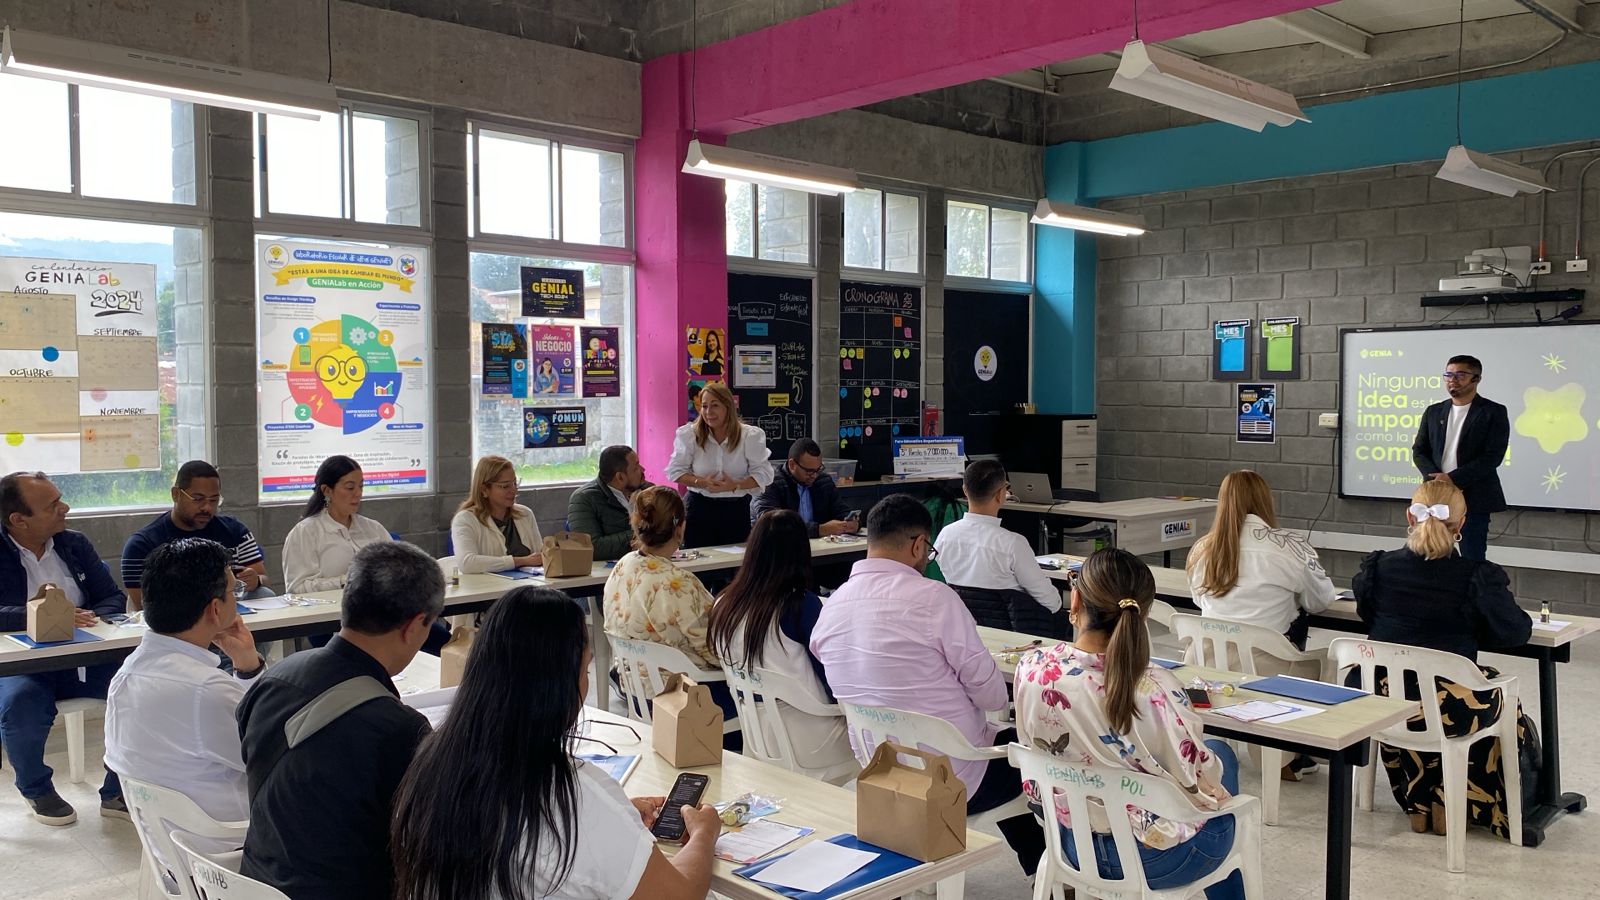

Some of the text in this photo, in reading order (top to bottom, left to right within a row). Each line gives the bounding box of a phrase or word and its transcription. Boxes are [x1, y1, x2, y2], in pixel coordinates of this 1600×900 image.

[312, 279, 346, 287] GENIALab
[532, 282, 574, 294] GENIAL
[14, 285, 49, 295] AGOSTO
[90, 288, 142, 310] 2024
[844, 288, 900, 308] CRONOGRAMA
[94, 328, 142, 336] SEPTIEMBRE
[536, 341, 572, 352] NEGOCIO
[10, 368, 53, 378] OCTUBRE
[1358, 372, 1441, 392] Ninguna
[1357, 390, 1408, 408] Idea
[1411, 399, 1425, 407] es
[552, 413, 584, 423] FOMUN
[1357, 410, 1422, 432] impor
[1355, 432, 1392, 442] como
[1121, 776, 1146, 796] POL
